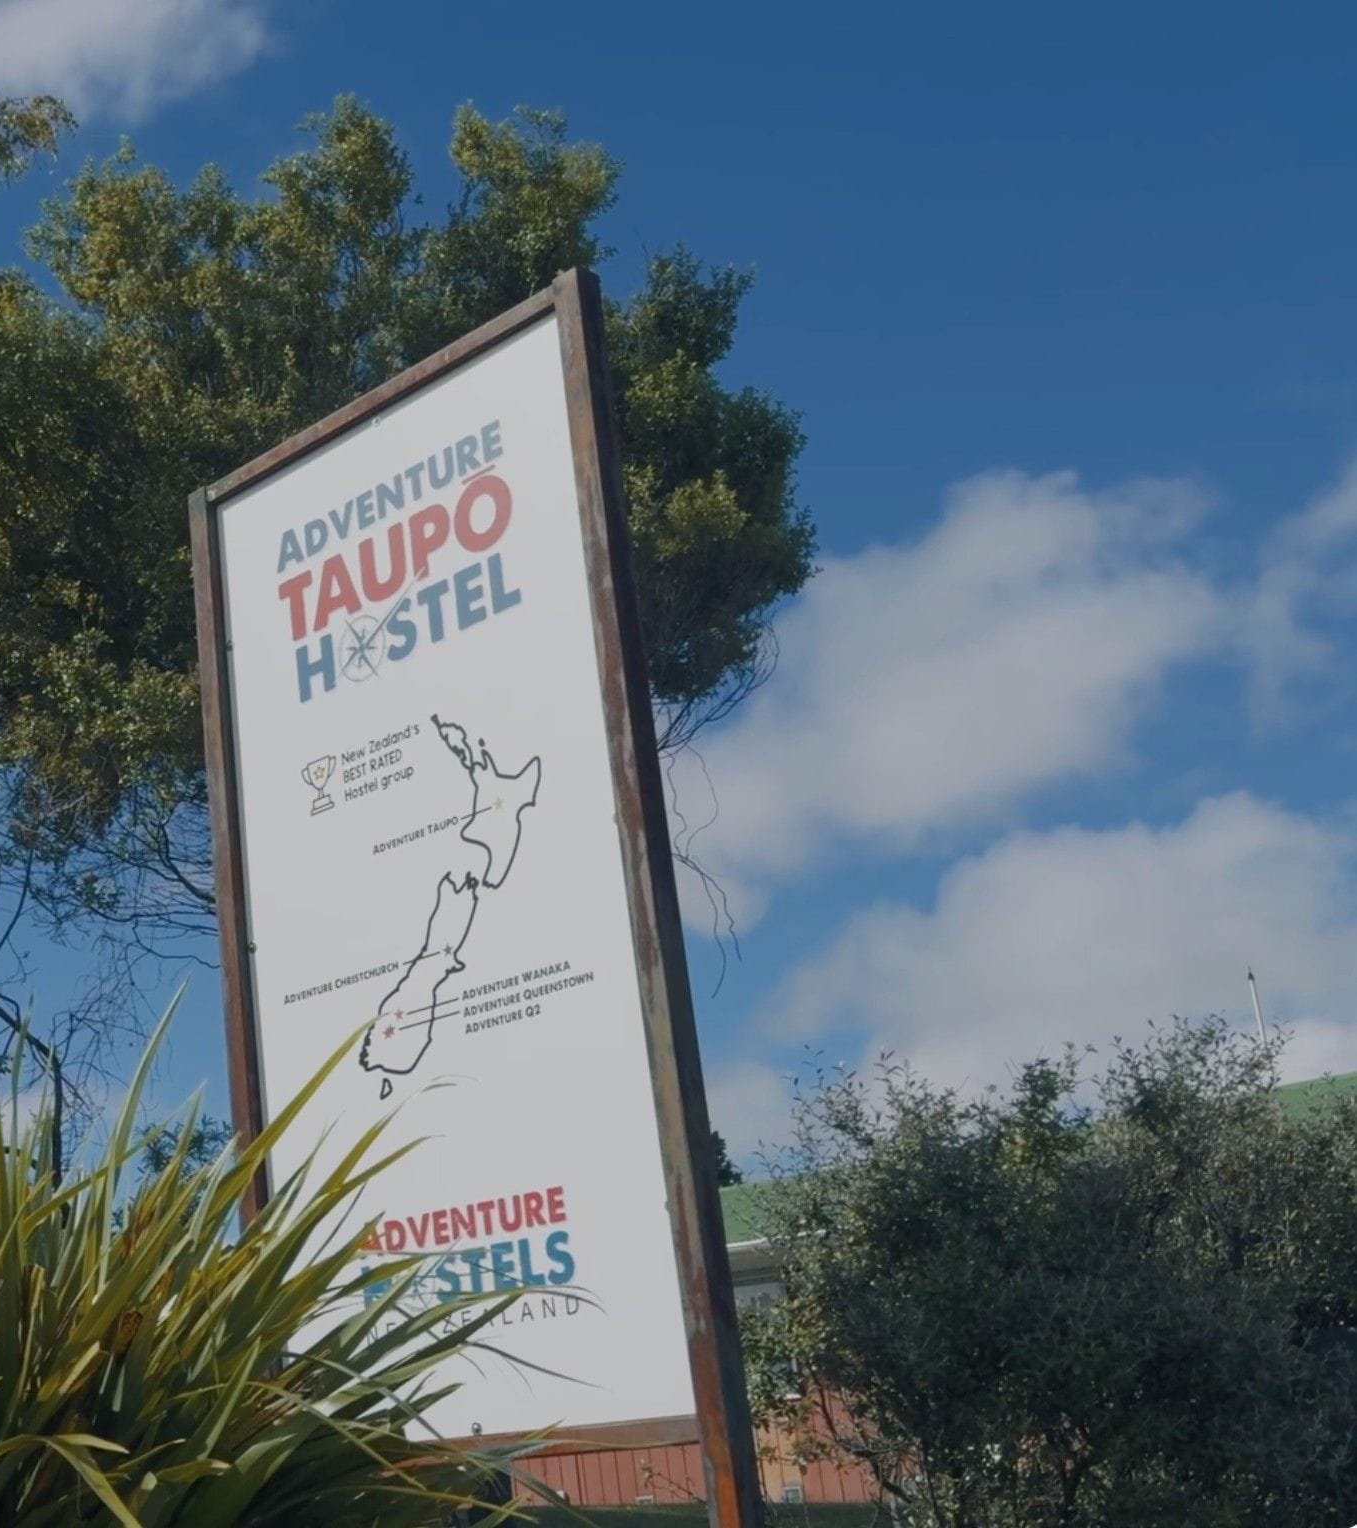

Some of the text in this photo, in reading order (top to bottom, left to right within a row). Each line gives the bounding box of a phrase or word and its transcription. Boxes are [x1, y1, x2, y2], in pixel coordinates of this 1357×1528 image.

[277, 419, 504, 574] ADVENTURE
[341, 724, 420, 765] New Zealand's
[343, 748, 402, 783] BEST RATED
[344, 766, 414, 801] Hostel group
[372, 828, 425, 855] ADVENTURE
[284, 961, 399, 1005] ADVENTURE CHRISTCHURCH
[462, 960, 571, 1001] ADVENTURE WANAKA
[463, 971, 594, 1018] ADVENTURE QUEENSTOWN
[465, 1004, 541, 1035] ADVENTURE Q2
